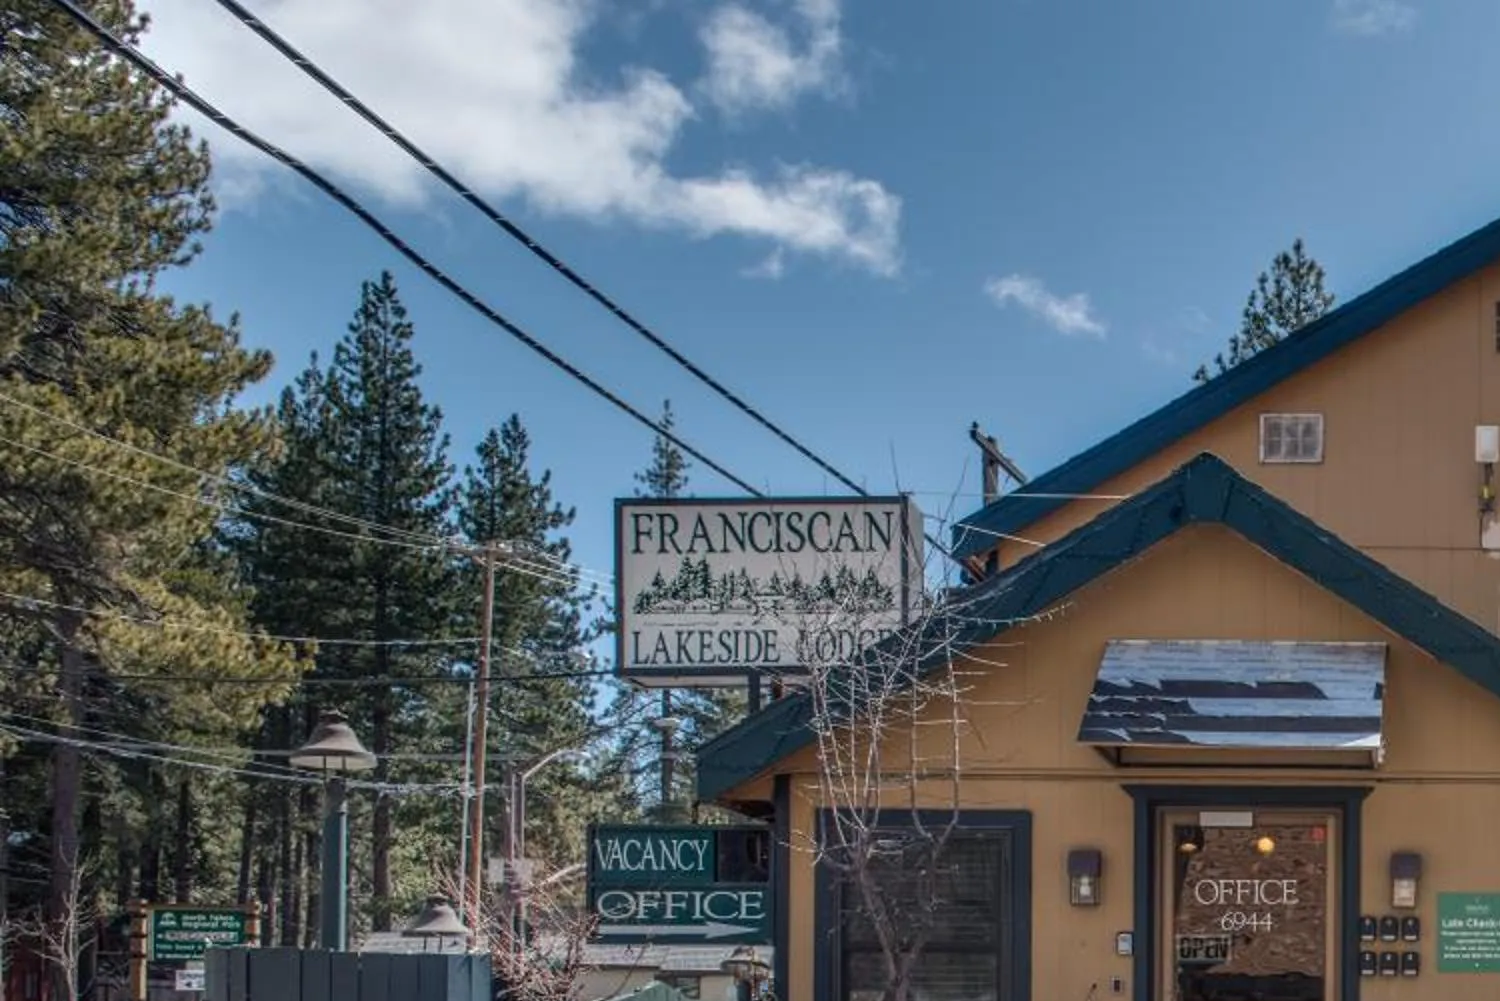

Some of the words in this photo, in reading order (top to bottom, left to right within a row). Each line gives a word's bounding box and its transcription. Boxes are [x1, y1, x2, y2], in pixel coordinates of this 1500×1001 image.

[631, 511, 894, 554] FRANCISCAN
[632, 630, 780, 664] LAKESIDE
[594, 836, 709, 871] VACANCY
[597, 890, 766, 920] OFFICE
[1195, 879, 1299, 905] OFFICE
[1221, 911, 1272, 932] 6944
[1180, 937, 1228, 958] OPEN
